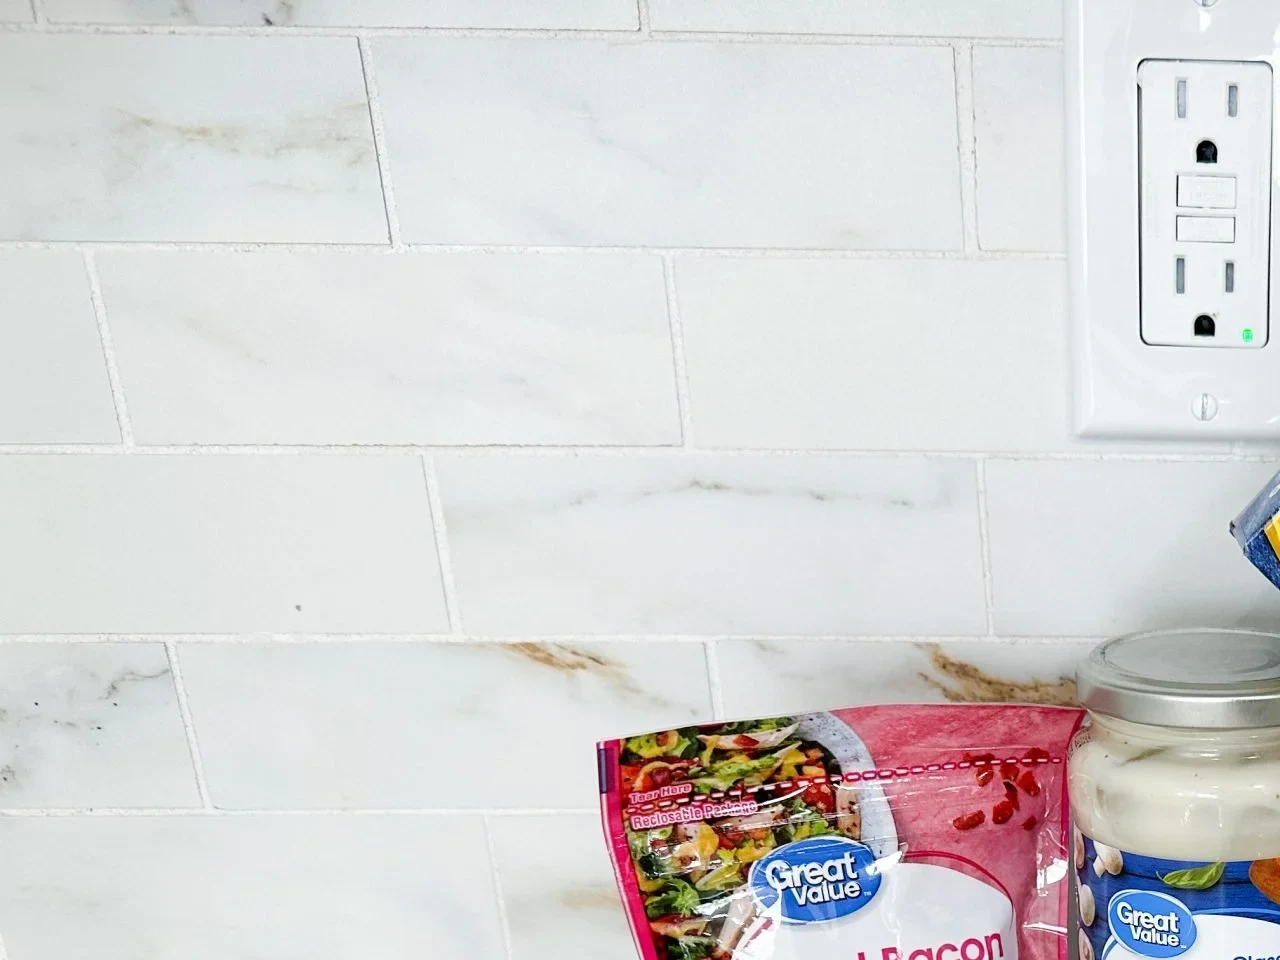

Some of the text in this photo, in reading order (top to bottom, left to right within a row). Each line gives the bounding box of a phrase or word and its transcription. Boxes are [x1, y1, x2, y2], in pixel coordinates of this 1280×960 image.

[630, 783, 692, 804] Tear Here
[632, 806, 704, 830] Reclosable
[766, 852, 859, 891] Great
[790, 880, 861, 906] Value
[1115, 901, 1180, 934] Great
[1131, 925, 1180, 948] Value
